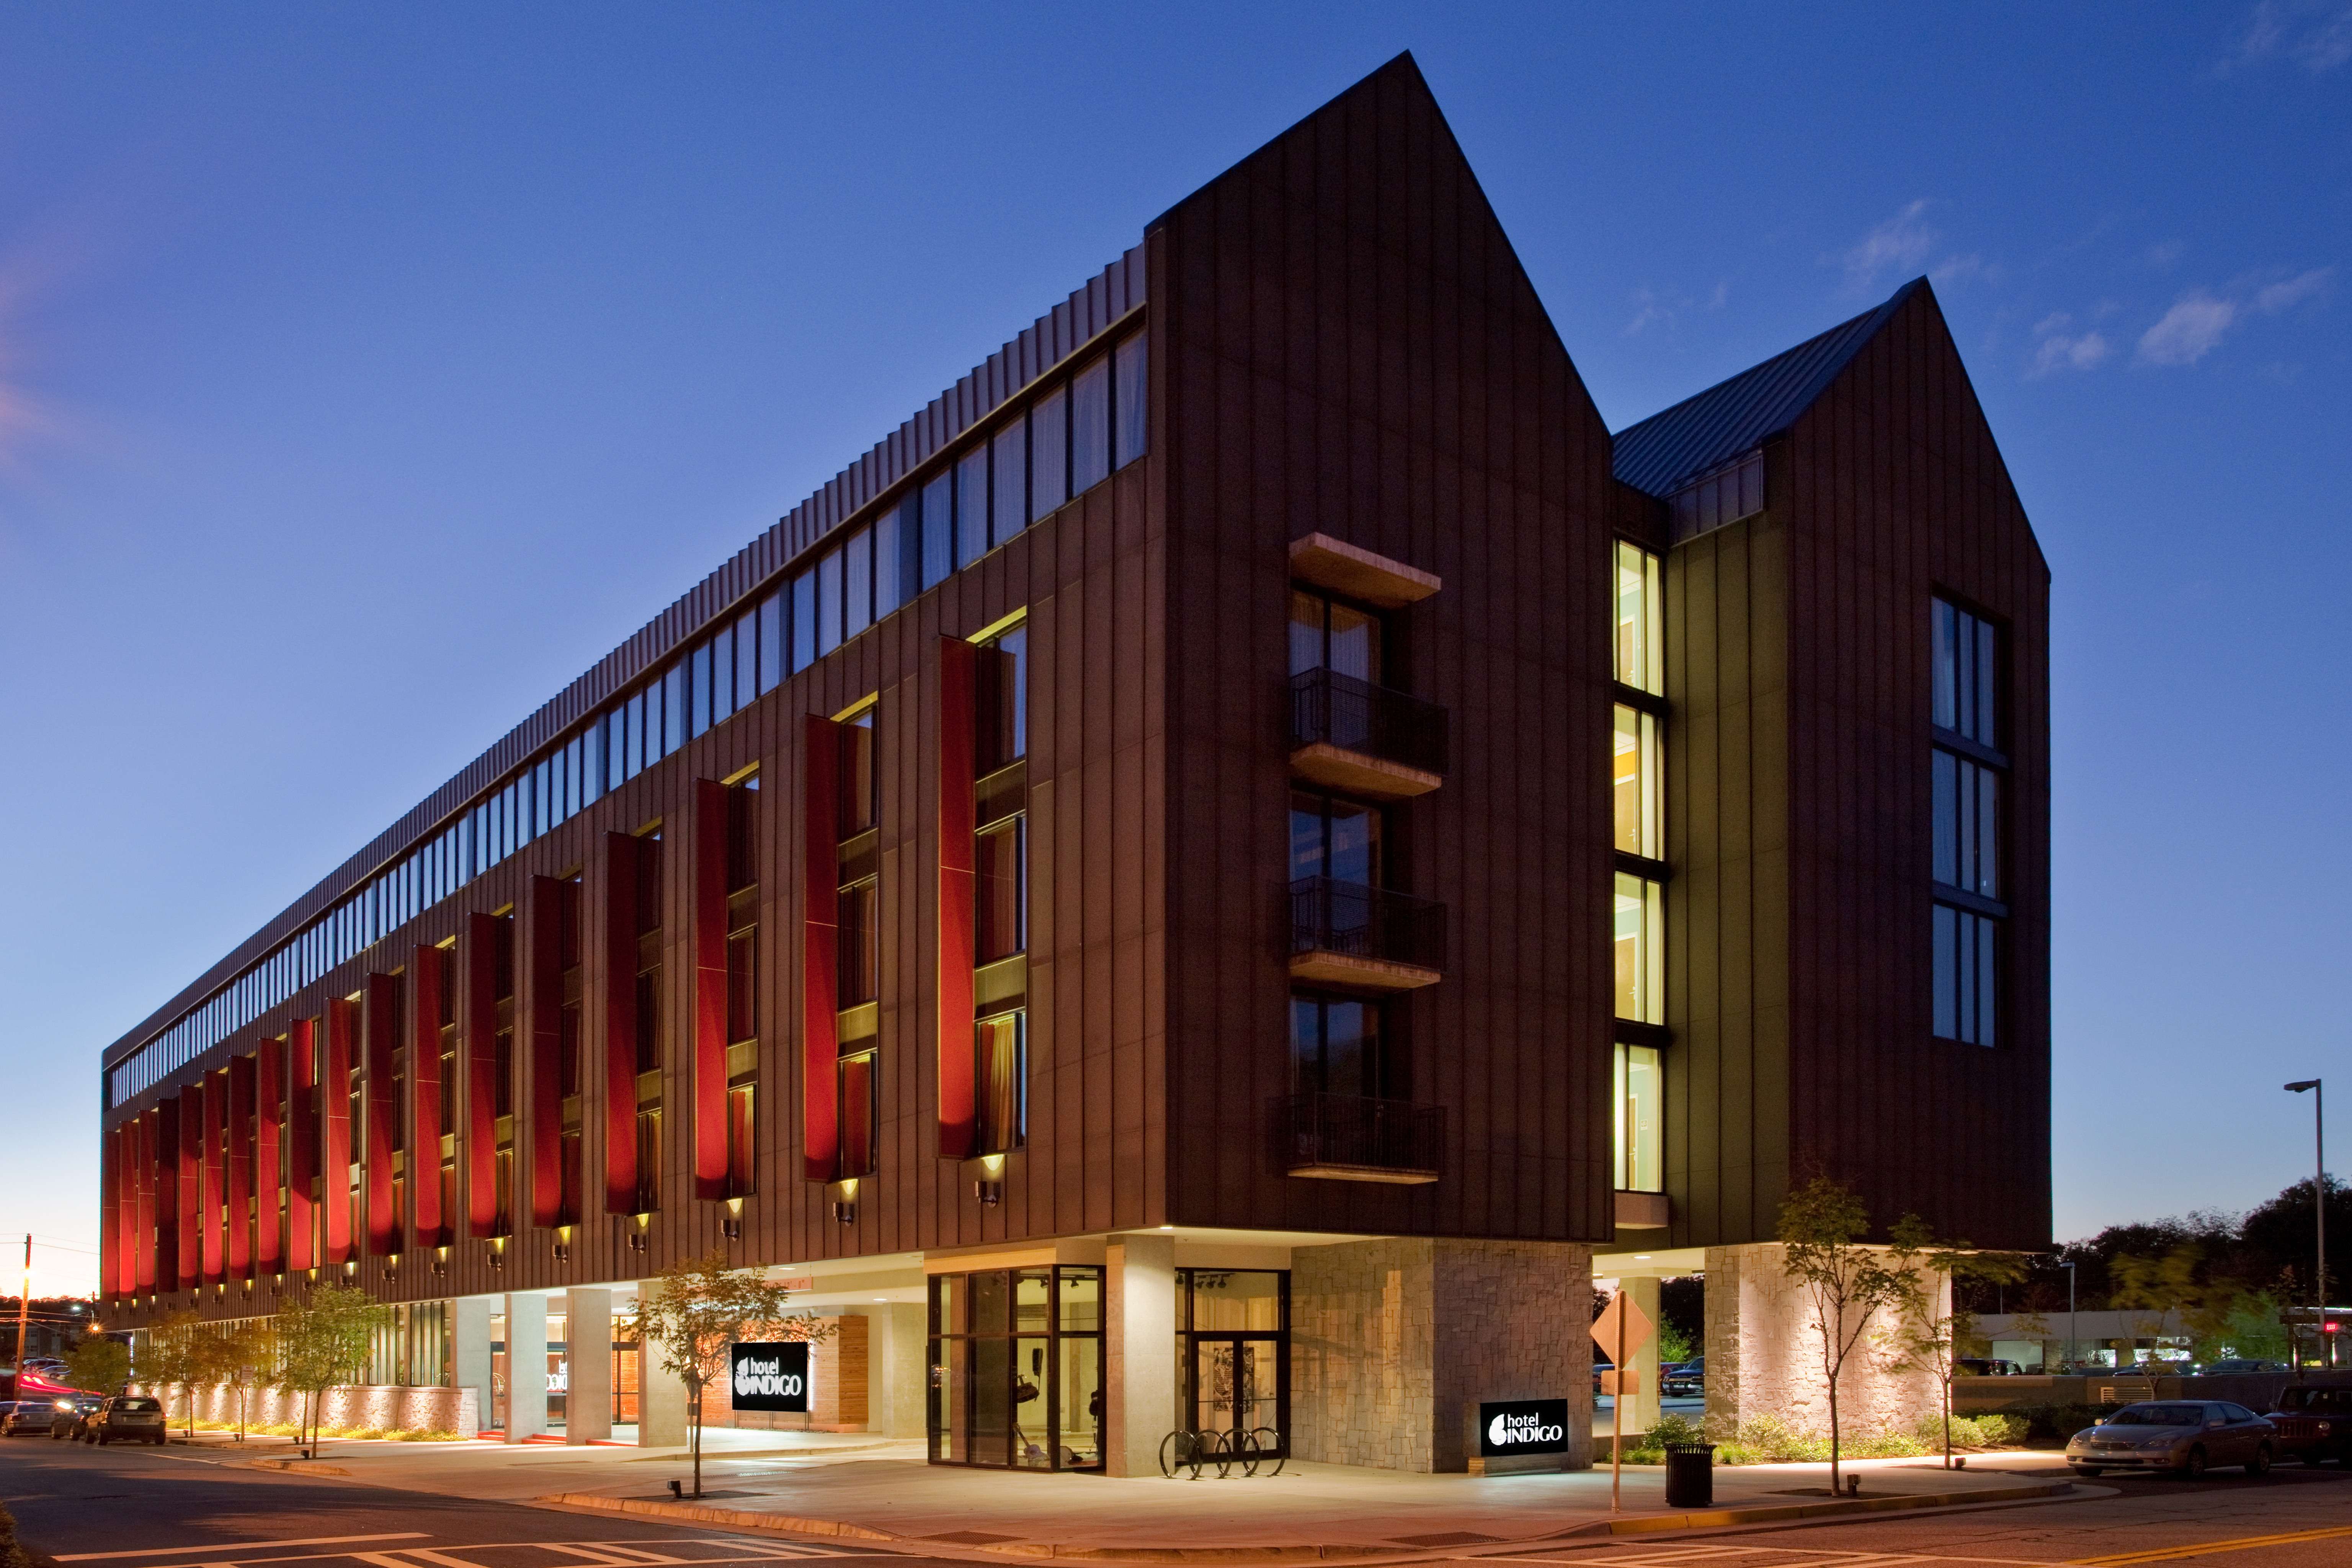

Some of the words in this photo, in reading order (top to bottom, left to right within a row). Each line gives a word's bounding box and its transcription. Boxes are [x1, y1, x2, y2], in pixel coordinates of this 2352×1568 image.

[751, 1357, 779, 1375] hotel
[750, 1375, 802, 1396] INDIGO
[1507, 1412, 1539, 1428] hotel
[1507, 1425, 1562, 1444] INDIGO
